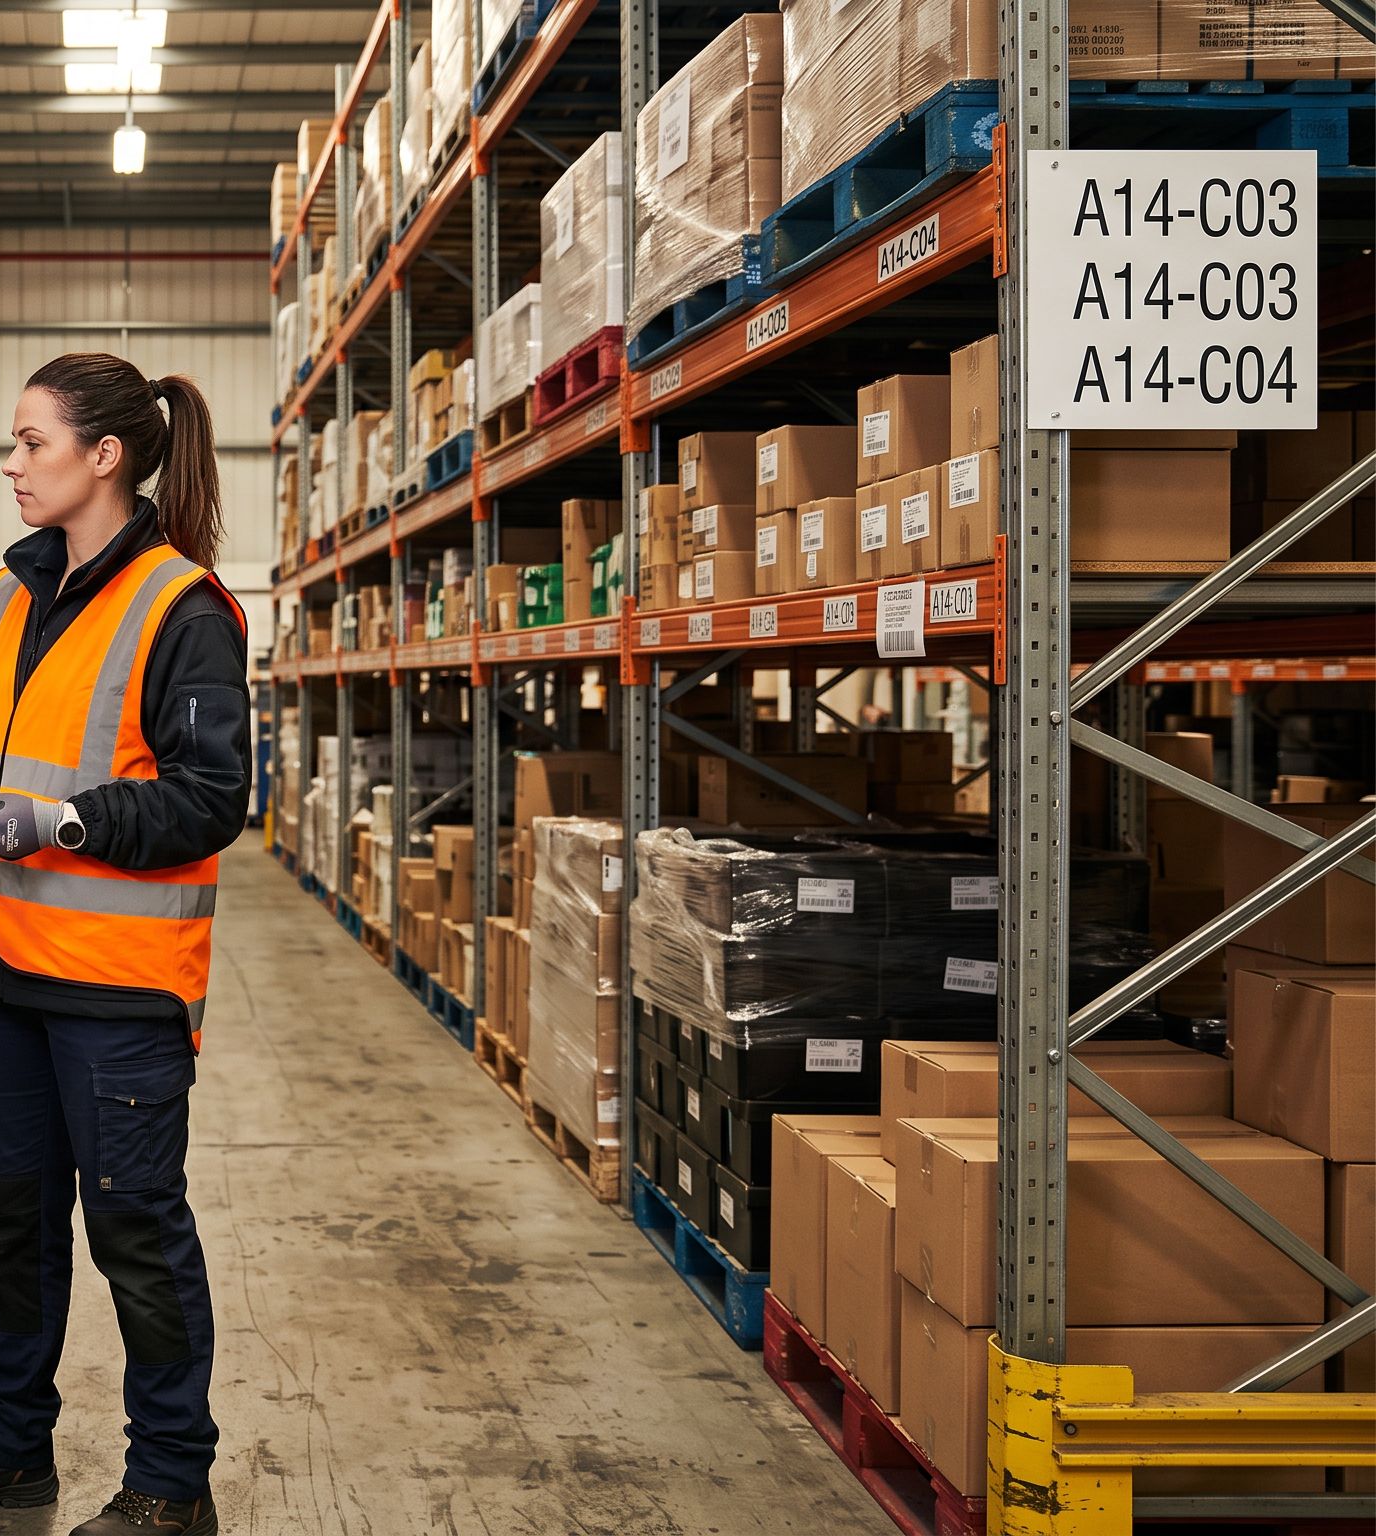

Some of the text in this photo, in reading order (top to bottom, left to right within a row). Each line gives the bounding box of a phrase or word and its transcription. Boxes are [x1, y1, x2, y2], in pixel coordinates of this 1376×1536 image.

[1073, 178, 1298, 238] A14-C03
[880, 221, 936, 278] A14-C04
[1072, 261, 1298, 321] A14-C03
[1073, 344, 1298, 405] A14-C04
